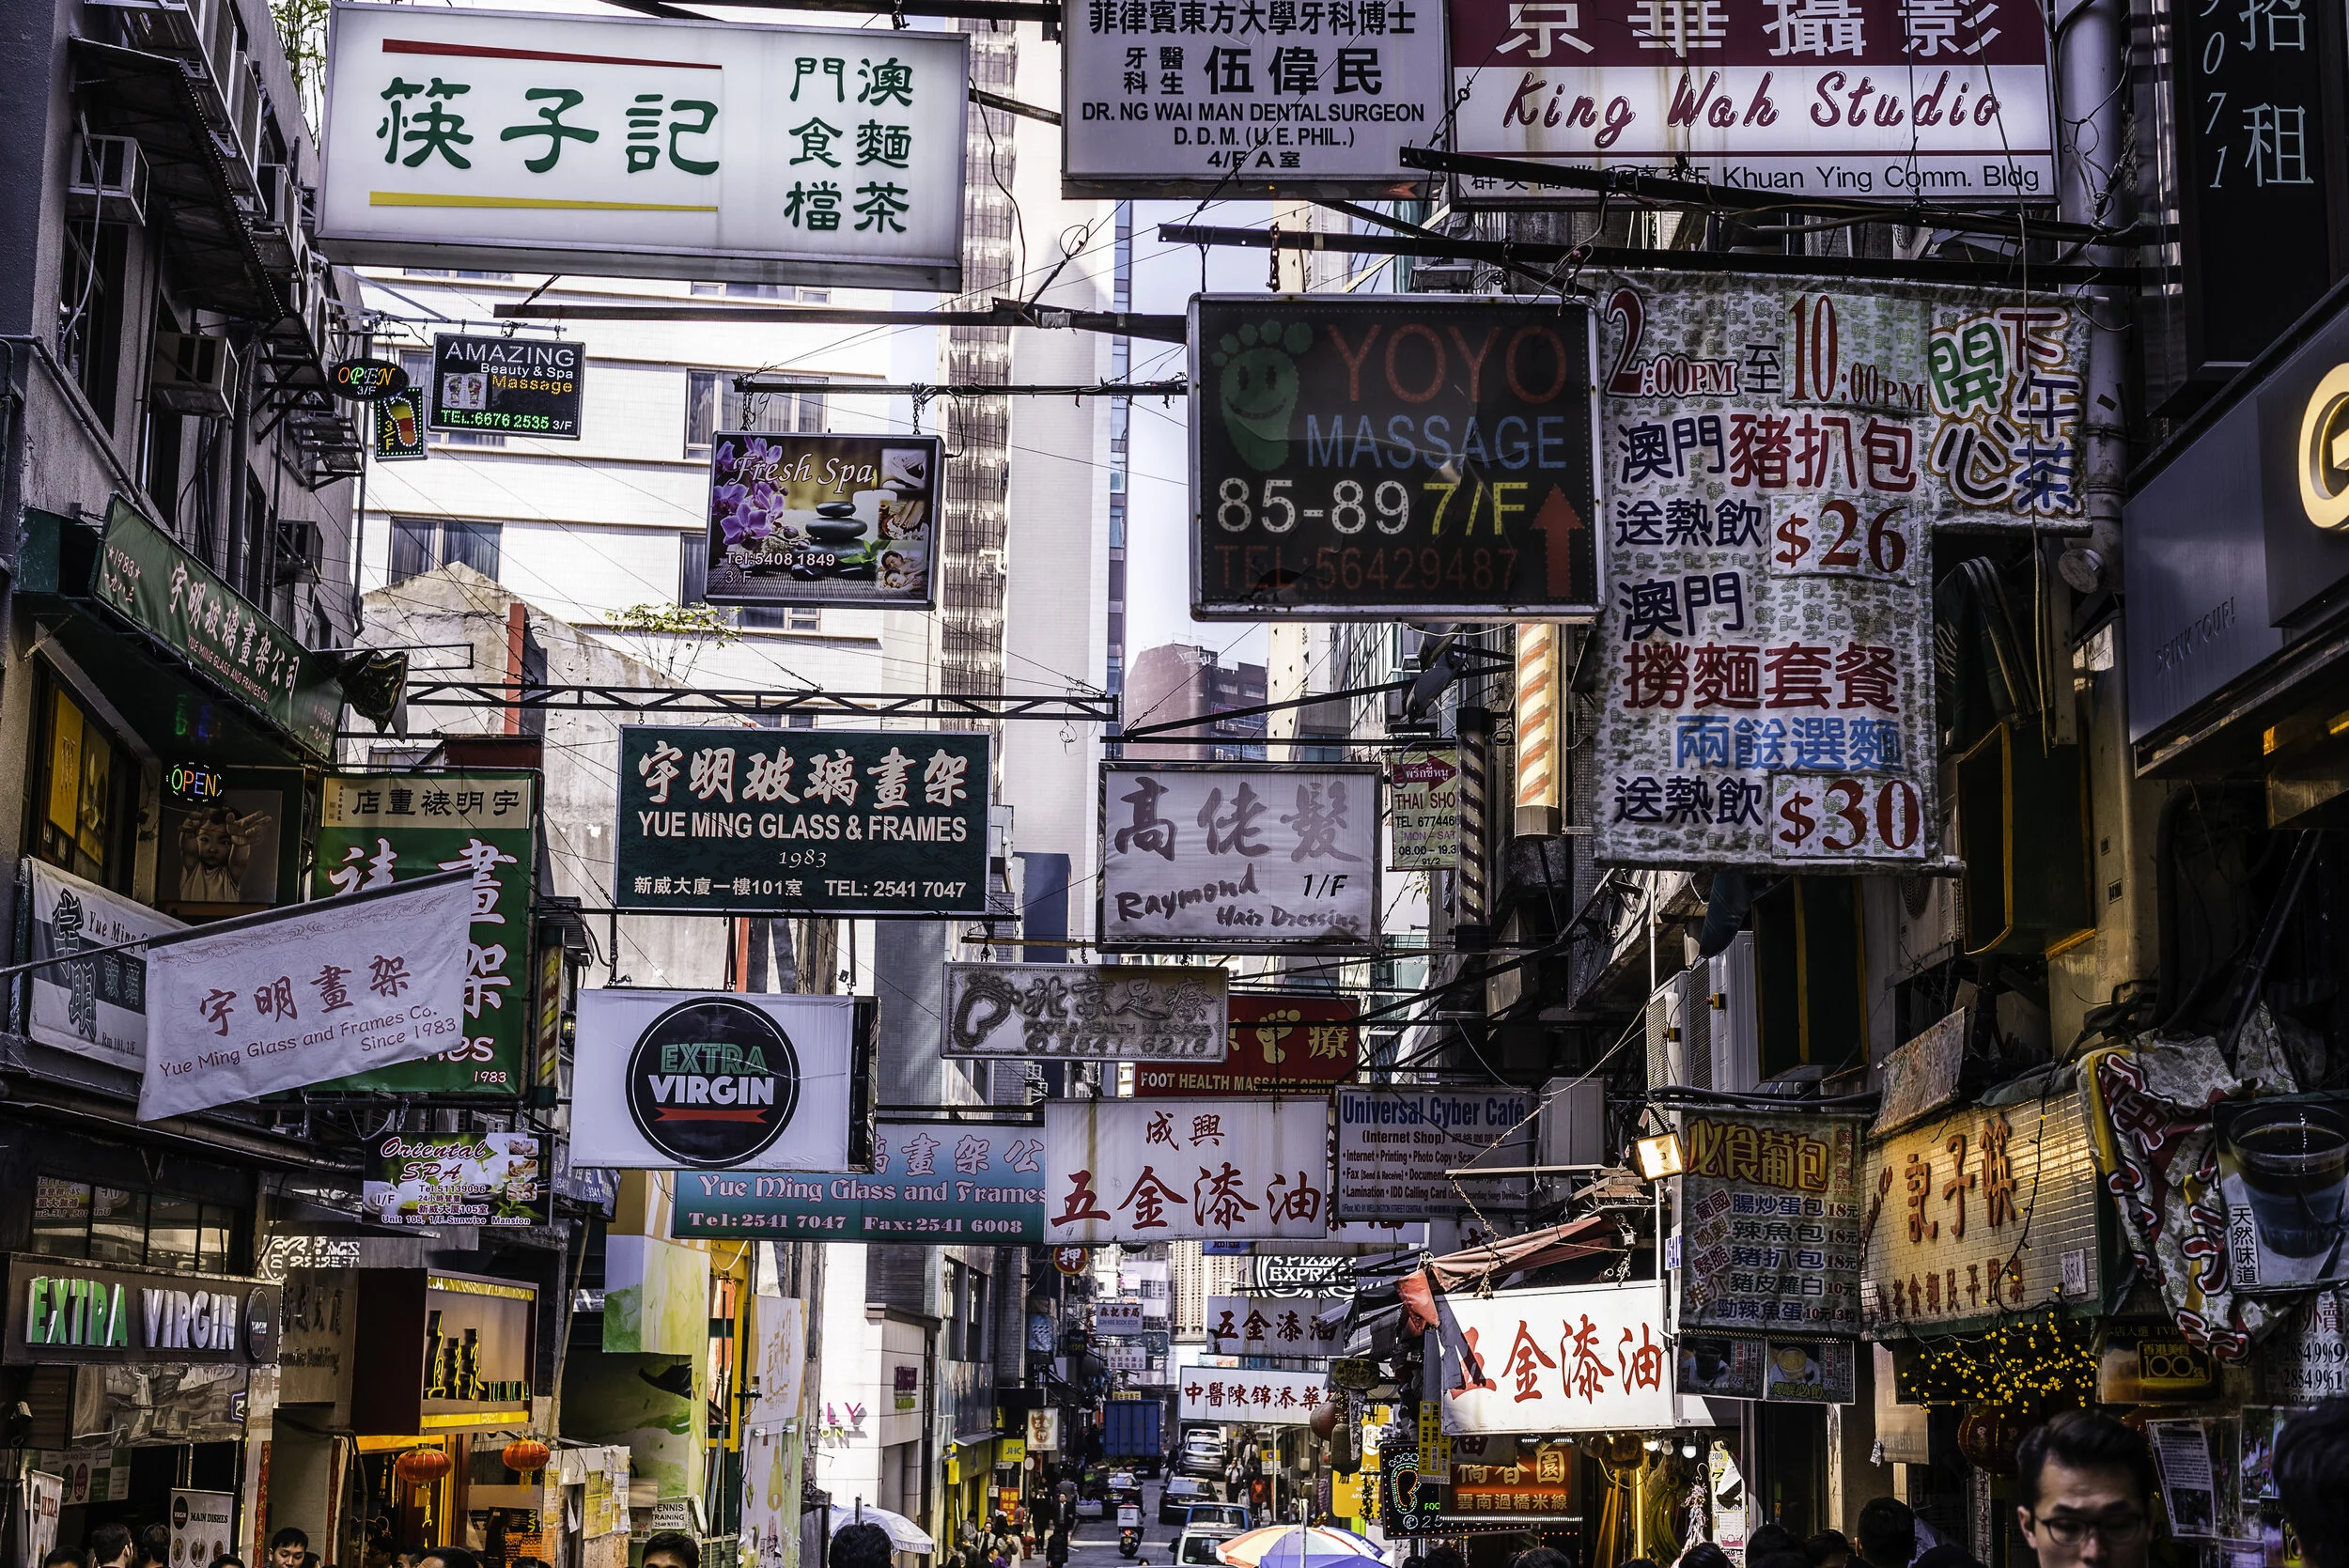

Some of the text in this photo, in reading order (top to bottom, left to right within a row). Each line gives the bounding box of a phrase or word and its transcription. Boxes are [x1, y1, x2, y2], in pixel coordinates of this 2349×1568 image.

[1089, 0, 1416, 36] 菲律賓東方大學牙科博士
[1204, 46, 1384, 96] 伍偉民
[1081, 102, 1244, 122] DR. NG WAI MAN
[1502, 70, 2002, 148] King Wah Studio
[376, 76, 720, 177] 筷子記
[1722, 165, 1805, 190] Khuan
[1815, 165, 1874, 194] Ying
[1884, 165, 1973, 190] Comm.
[1983, 164, 2040, 193] Bldg
[444, 341, 575, 367] AMAZING
[1326, 323, 1568, 405] YOYO
[1745, 342, 1781, 395] 至
[337, 365, 397, 388] OPEN
[480, 363, 574, 380] Beauty & Spa
[491, 375, 573, 396] Massage
[356, 385, 377, 396] 3/F
[513, 412, 572, 431] 2535 3/F
[1306, 414, 1568, 470] MASSAGE
[1617, 413, 1918, 493] 澳門豬扒包
[728, 453, 875, 495] Fresh Spa
[1216, 476, 1530, 536] 85-89 7/F
[1614, 498, 1763, 549] 送熱飲
[1775, 499, 1910, 574] $26
[724, 551, 836, 567] Tel:5408 1849
[1618, 570, 1745, 642] 澳門
[188, 634, 262, 700] YUE MING GLASS AND FRAMES
[1622, 641, 1900, 714] 撈麵套餐
[171, 768, 217, 797] OPEN
[638, 740, 969, 810] 宇明玻璃畫架
[1394, 792, 1423, 810] THAI
[1612, 776, 1764, 828] 送熱飲
[1779, 779, 1921, 851] $30
[637, 810, 968, 843] YUE MING GLASS & FRAMES
[1394, 815, 1413, 829] TEL
[1403, 831, 1427, 842] MON
[778, 847, 829, 870] 1983
[824, 879, 967, 899] TEL: 2541 7047
[1113, 862, 1261, 924] Raymond
[1302, 873, 1349, 901] 1/F
[88, 910, 107, 937] Yue
[1215, 904, 1363, 934] Hair Dressing
[198, 954, 412, 1037] 宇明畫架
[159, 1004, 438, 1079] Yue Ming Glass and Frames Co.
[360, 1032, 407, 1052] Since
[412, 1017, 458, 1040] 1983
[660, 1042, 770, 1076] EXTRA
[474, 1070, 507, 1084] 1983
[647, 1074, 775, 1106] VIRGIN
[1141, 1071, 1175, 1088] FOOT
[1178, 1073, 1231, 1091] HEALTH
[1342, 1094, 1526, 1129] Universal Cyber Café
[381, 1136, 488, 1160] Oriental
[1346, 1149, 1453, 1166] Internet Printing Photo Copy
[400, 1161, 463, 1183] SPA
[1346, 1168, 1361, 1181] Fax
[698, 1174, 1046, 1205] Yue Ming Glass and Frames
[1050, 1160, 1324, 1232] 五金漆油
[1346, 1185, 1385, 1199] Lamination
[1390, 1186, 1404, 1199] IDD
[1404, 1186, 1429, 1202] Calling
[1429, 1186, 1447, 1200] Card
[381, 1215, 403, 1225] Unit
[447, 1216, 488, 1225] Sunwise
[490, 1216, 531, 1226] Mansion
[796, 1214, 848, 1230] 7047
[970, 1219, 1023, 1234] 6008
[1268, 1266, 1357, 1282] EXPRE
[26, 1276, 238, 1351] EXTRA VIRGIN
[1183, 1381, 1334, 1411] 中醫陳錦添藥
[1456, 1493, 1568, 1512] 雲南過橋米線
[190, 1512, 228, 1524] MAIN DISHES
